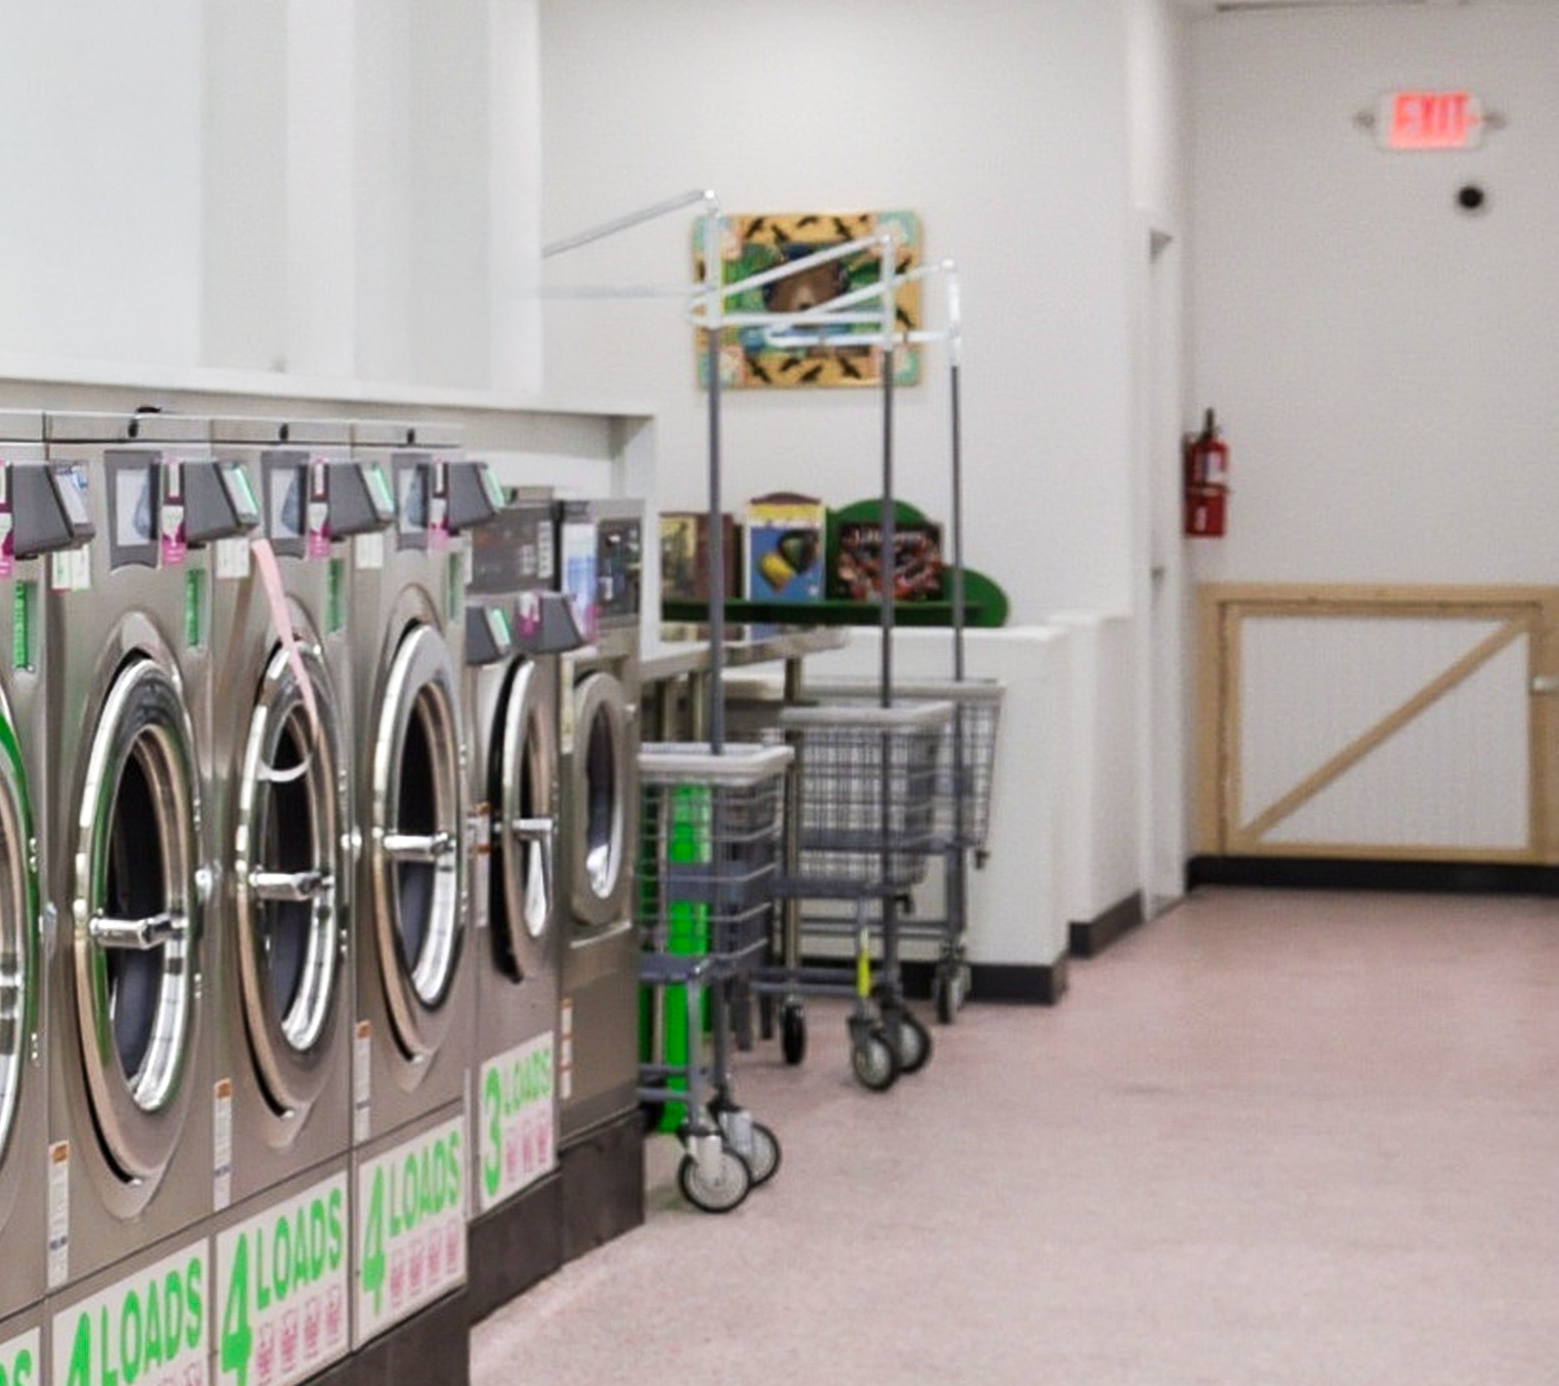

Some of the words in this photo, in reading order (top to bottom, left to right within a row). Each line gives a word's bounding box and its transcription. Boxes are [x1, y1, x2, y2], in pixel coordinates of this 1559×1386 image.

[484, 1068, 501, 1196] 3
[256, 1186, 342, 1312] LOADS
[362, 1166, 387, 1316] 4
[388, 1130, 460, 1235] LOADS
